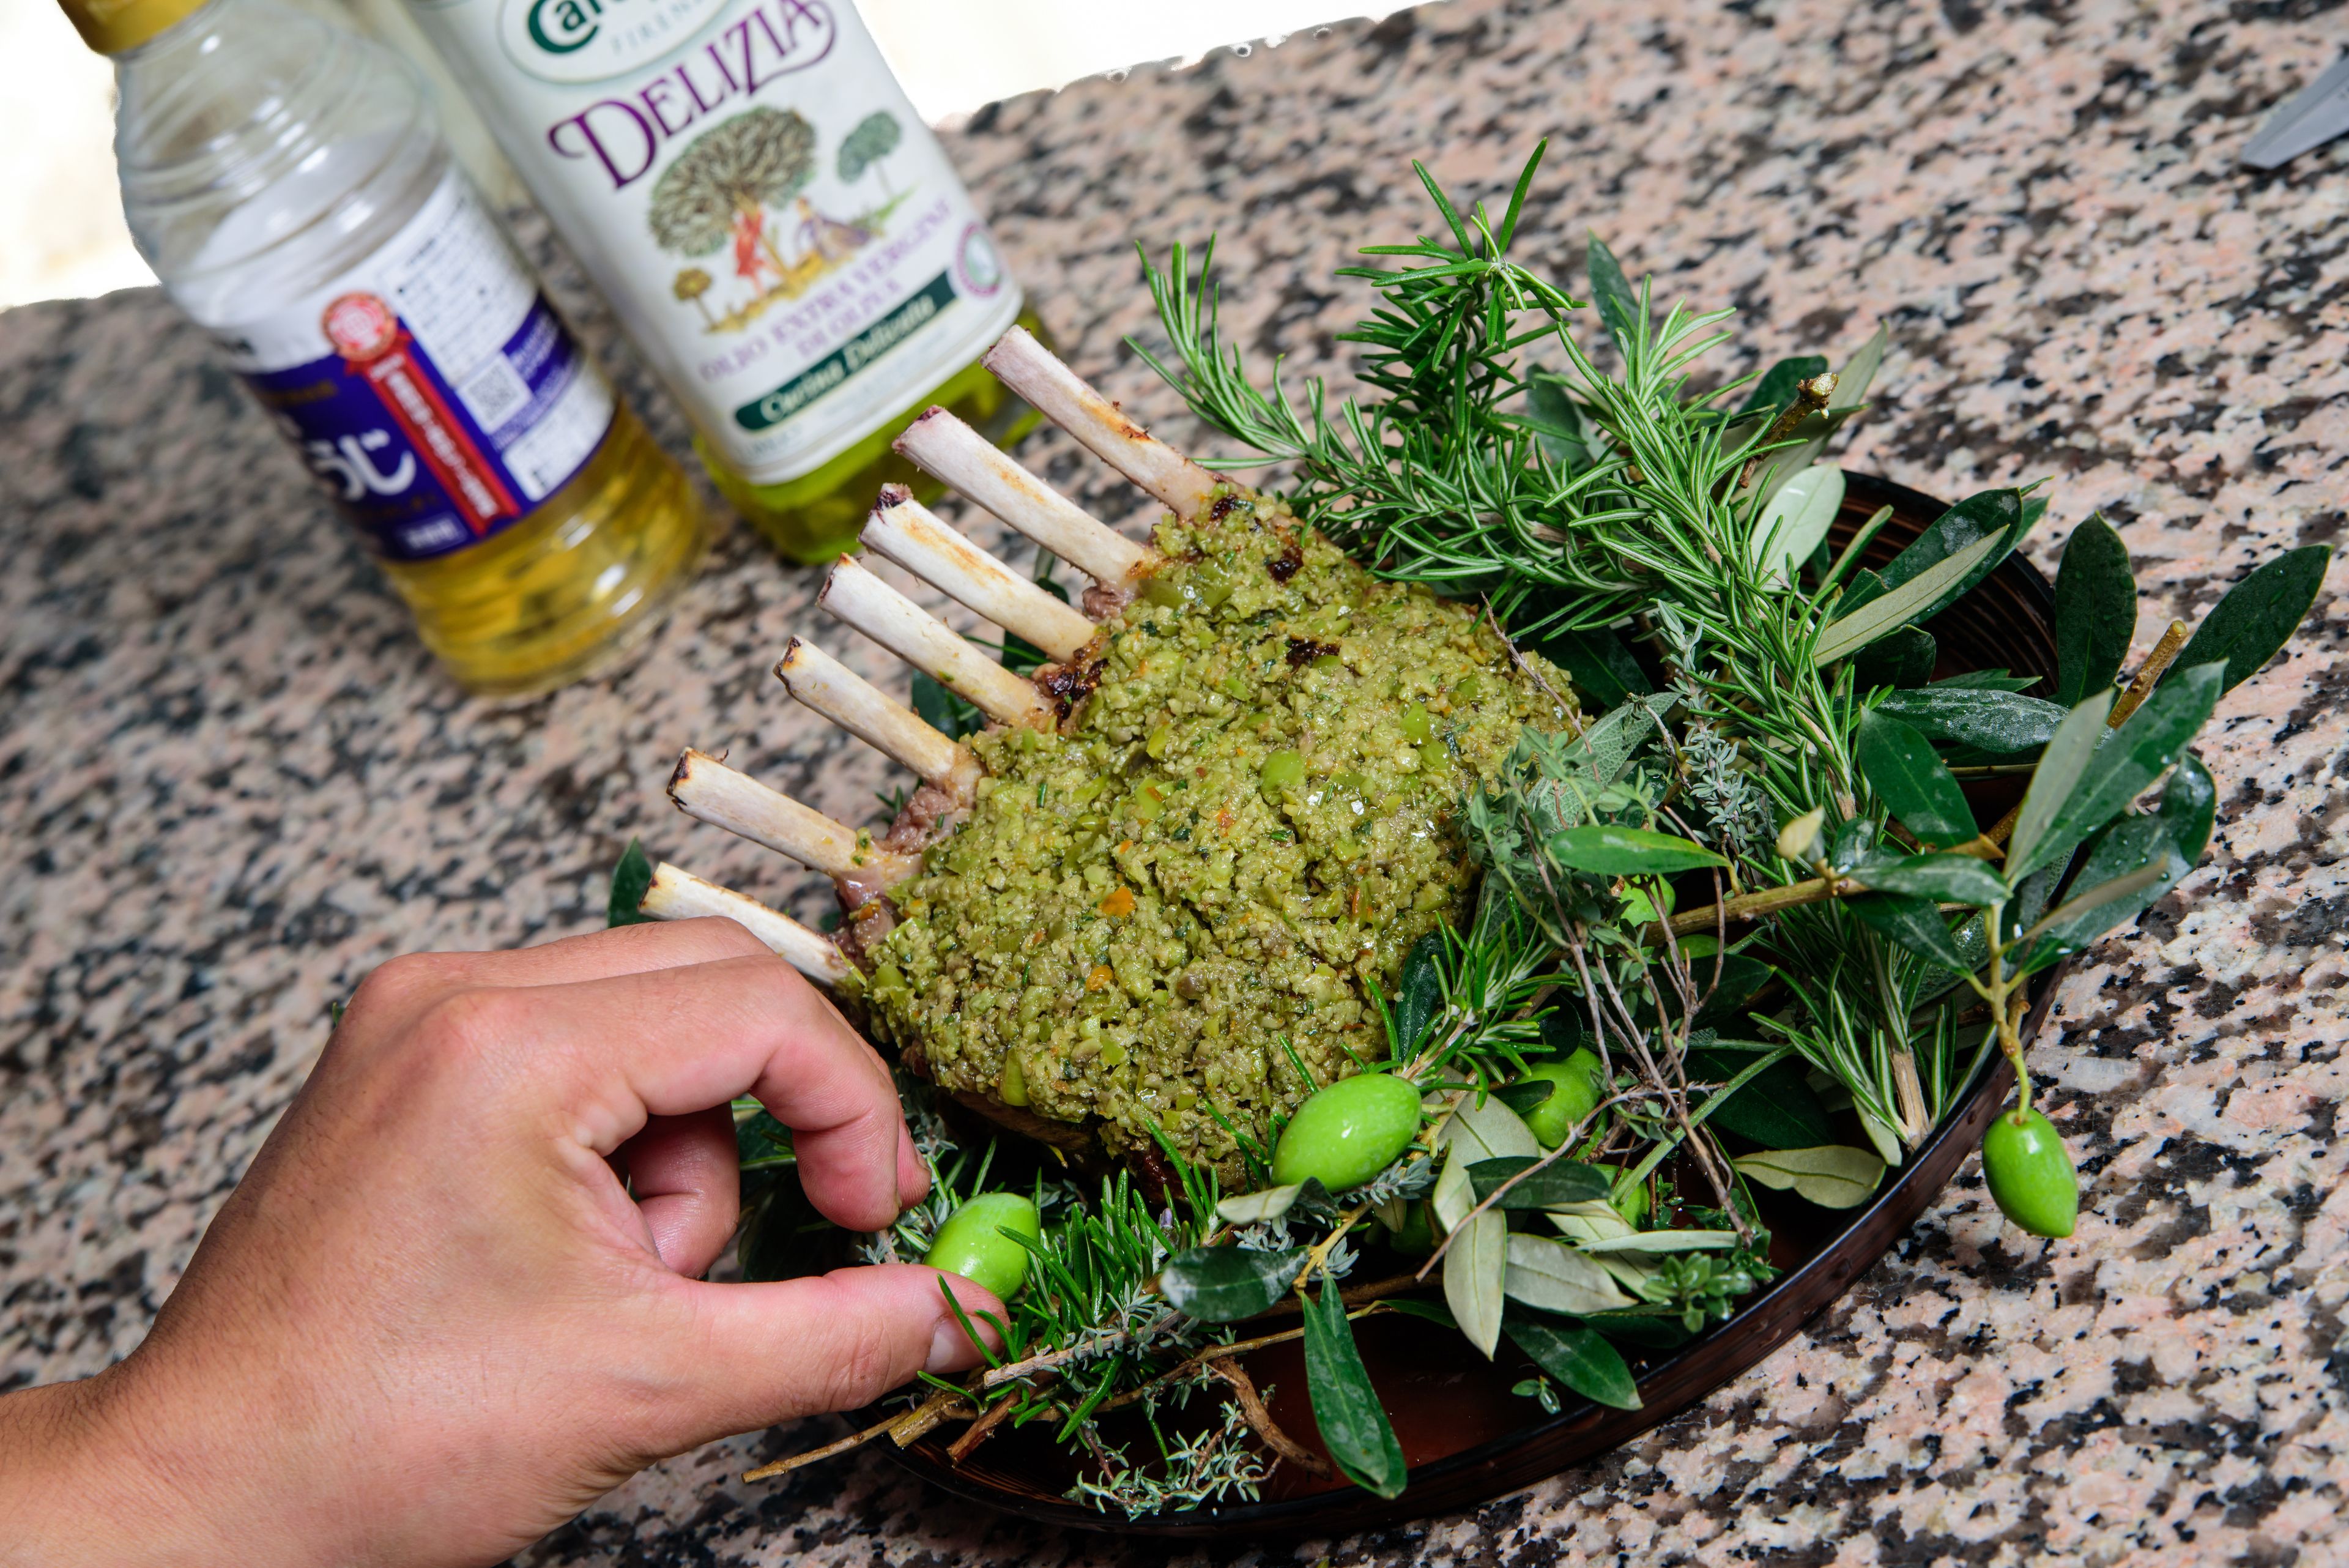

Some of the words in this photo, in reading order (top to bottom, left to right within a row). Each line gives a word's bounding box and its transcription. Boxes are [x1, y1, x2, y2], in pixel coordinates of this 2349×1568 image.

[547, 0, 836, 189] DELIZIA
[698, 335, 768, 382] OLIO
[771, 280, 856, 344] EXTRA
[852, 198, 951, 283] VERGINE
[795, 330, 828, 357] DI
[828, 278, 900, 337] OLIVA
